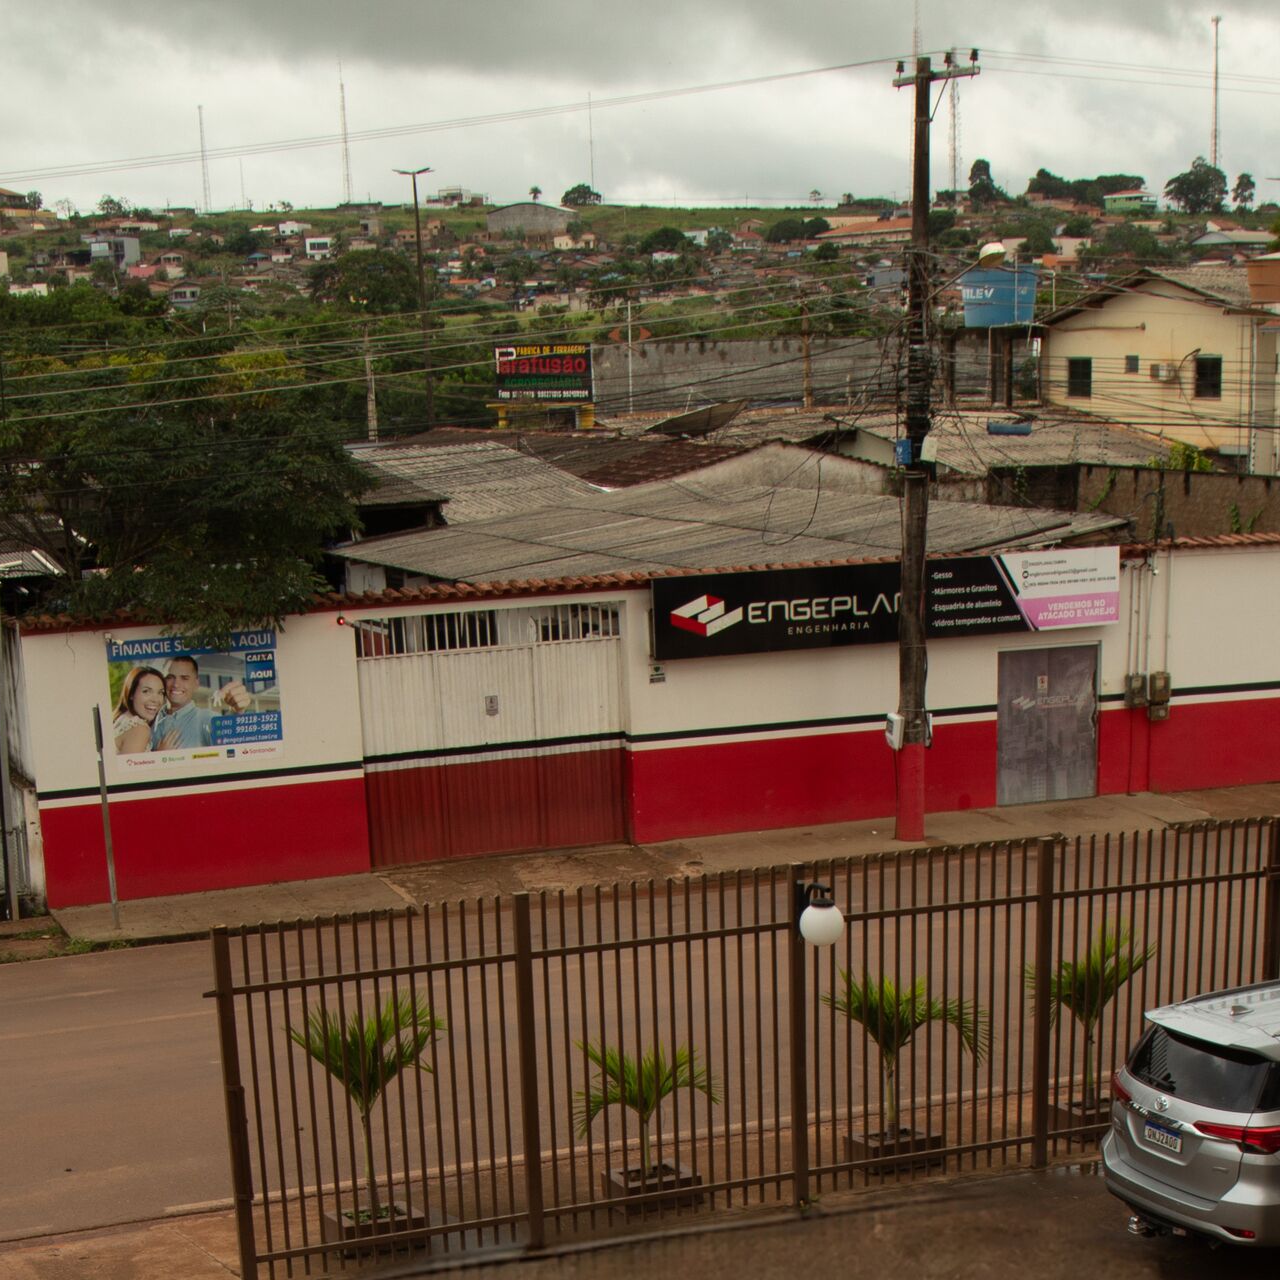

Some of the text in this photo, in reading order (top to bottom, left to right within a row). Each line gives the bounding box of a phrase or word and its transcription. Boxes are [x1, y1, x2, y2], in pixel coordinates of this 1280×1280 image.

[971, 584, 998, 593] Granitos
[1048, 599, 1106, 611] VENDEMOS NO
[956, 615, 992, 626] temperados
[997, 614, 1021, 623] comuns
[1038, 610, 1075, 621] ATACADO
[1083, 607, 1116, 617] VAREJO
[787, 621, 870, 636] ENGENHARIA
[112, 641, 171, 656] FINANCIE
[239, 633, 271, 647] AQUI
[246, 653, 272, 662] CAIXA
[249, 670, 272, 679] AQUI
